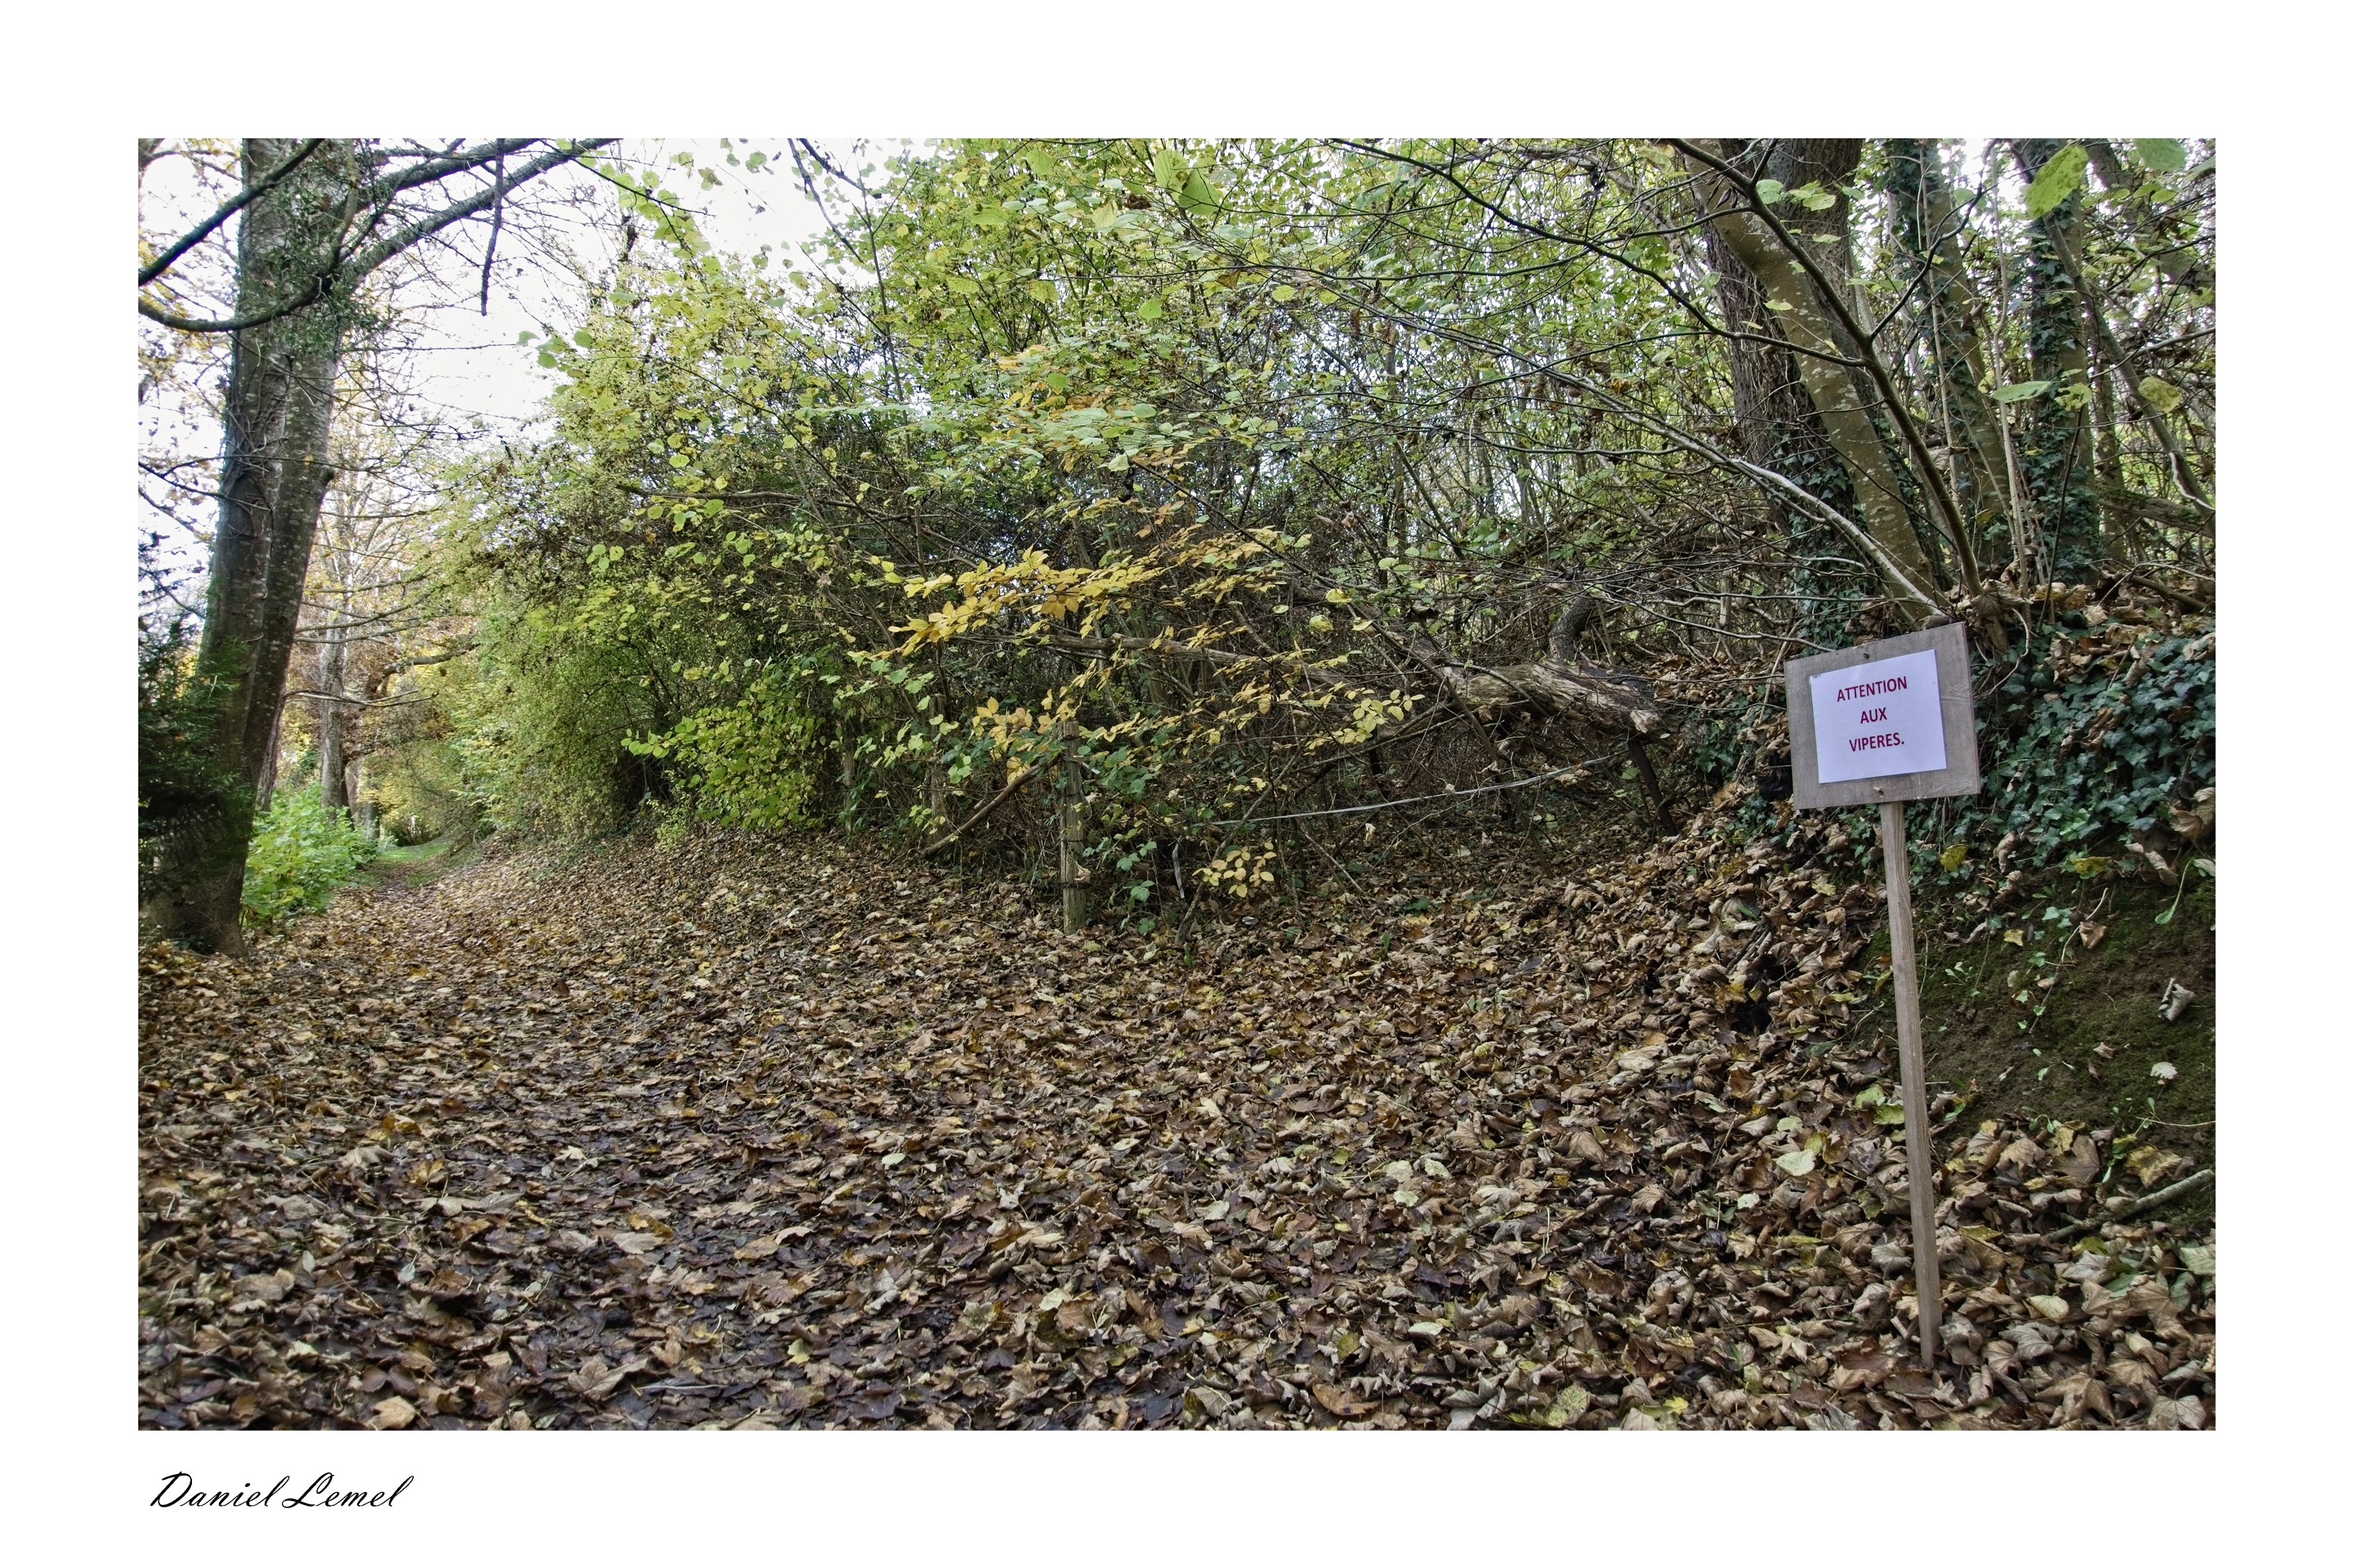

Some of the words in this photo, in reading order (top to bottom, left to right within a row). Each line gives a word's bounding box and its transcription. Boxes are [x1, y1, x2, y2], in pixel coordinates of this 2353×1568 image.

[1837, 676, 1908, 703] ATTENTION
[1860, 707, 1888, 725] AUX
[1849, 732, 1905, 753] VIPERES.
